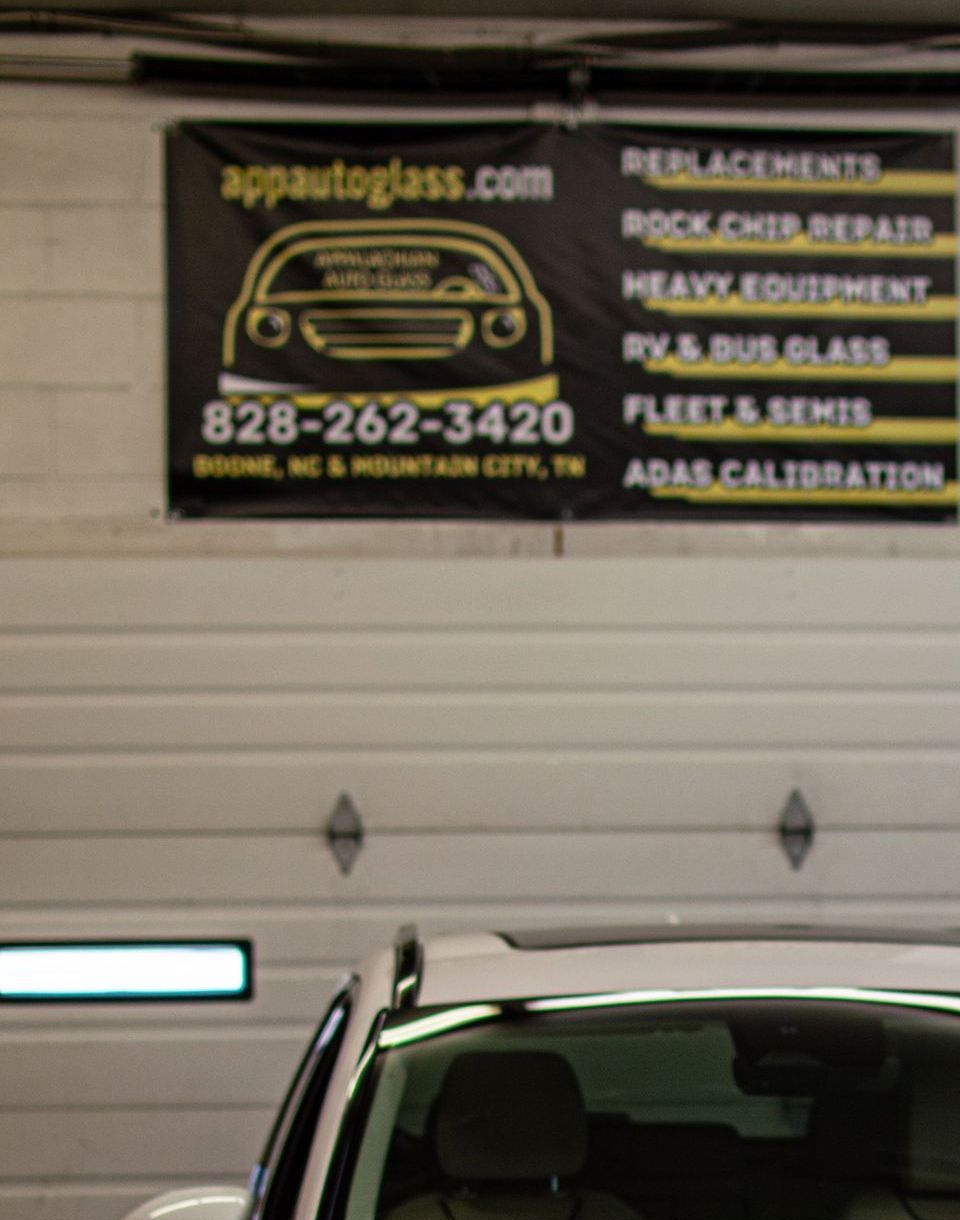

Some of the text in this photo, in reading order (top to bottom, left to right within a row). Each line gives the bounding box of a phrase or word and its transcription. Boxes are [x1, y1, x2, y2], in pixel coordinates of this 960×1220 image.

[622, 147, 881, 181] REPLACEMENTS
[221, 157, 553, 210] appautoglass.com
[622, 209, 933, 246] ROCK CHIP REPAIR
[622, 271, 931, 305] HEAVY EQUIPMENT
[622, 333, 890, 366] RV & BUS GLASS
[202, 401, 574, 444] 828-262-3420
[623, 395, 872, 428] FLEET & SEMIS
[192, 454, 586, 480] BOONE, NC & MOUNTAIN CITY, TN
[623, 458, 944, 491] ADAS CALIBRATION
